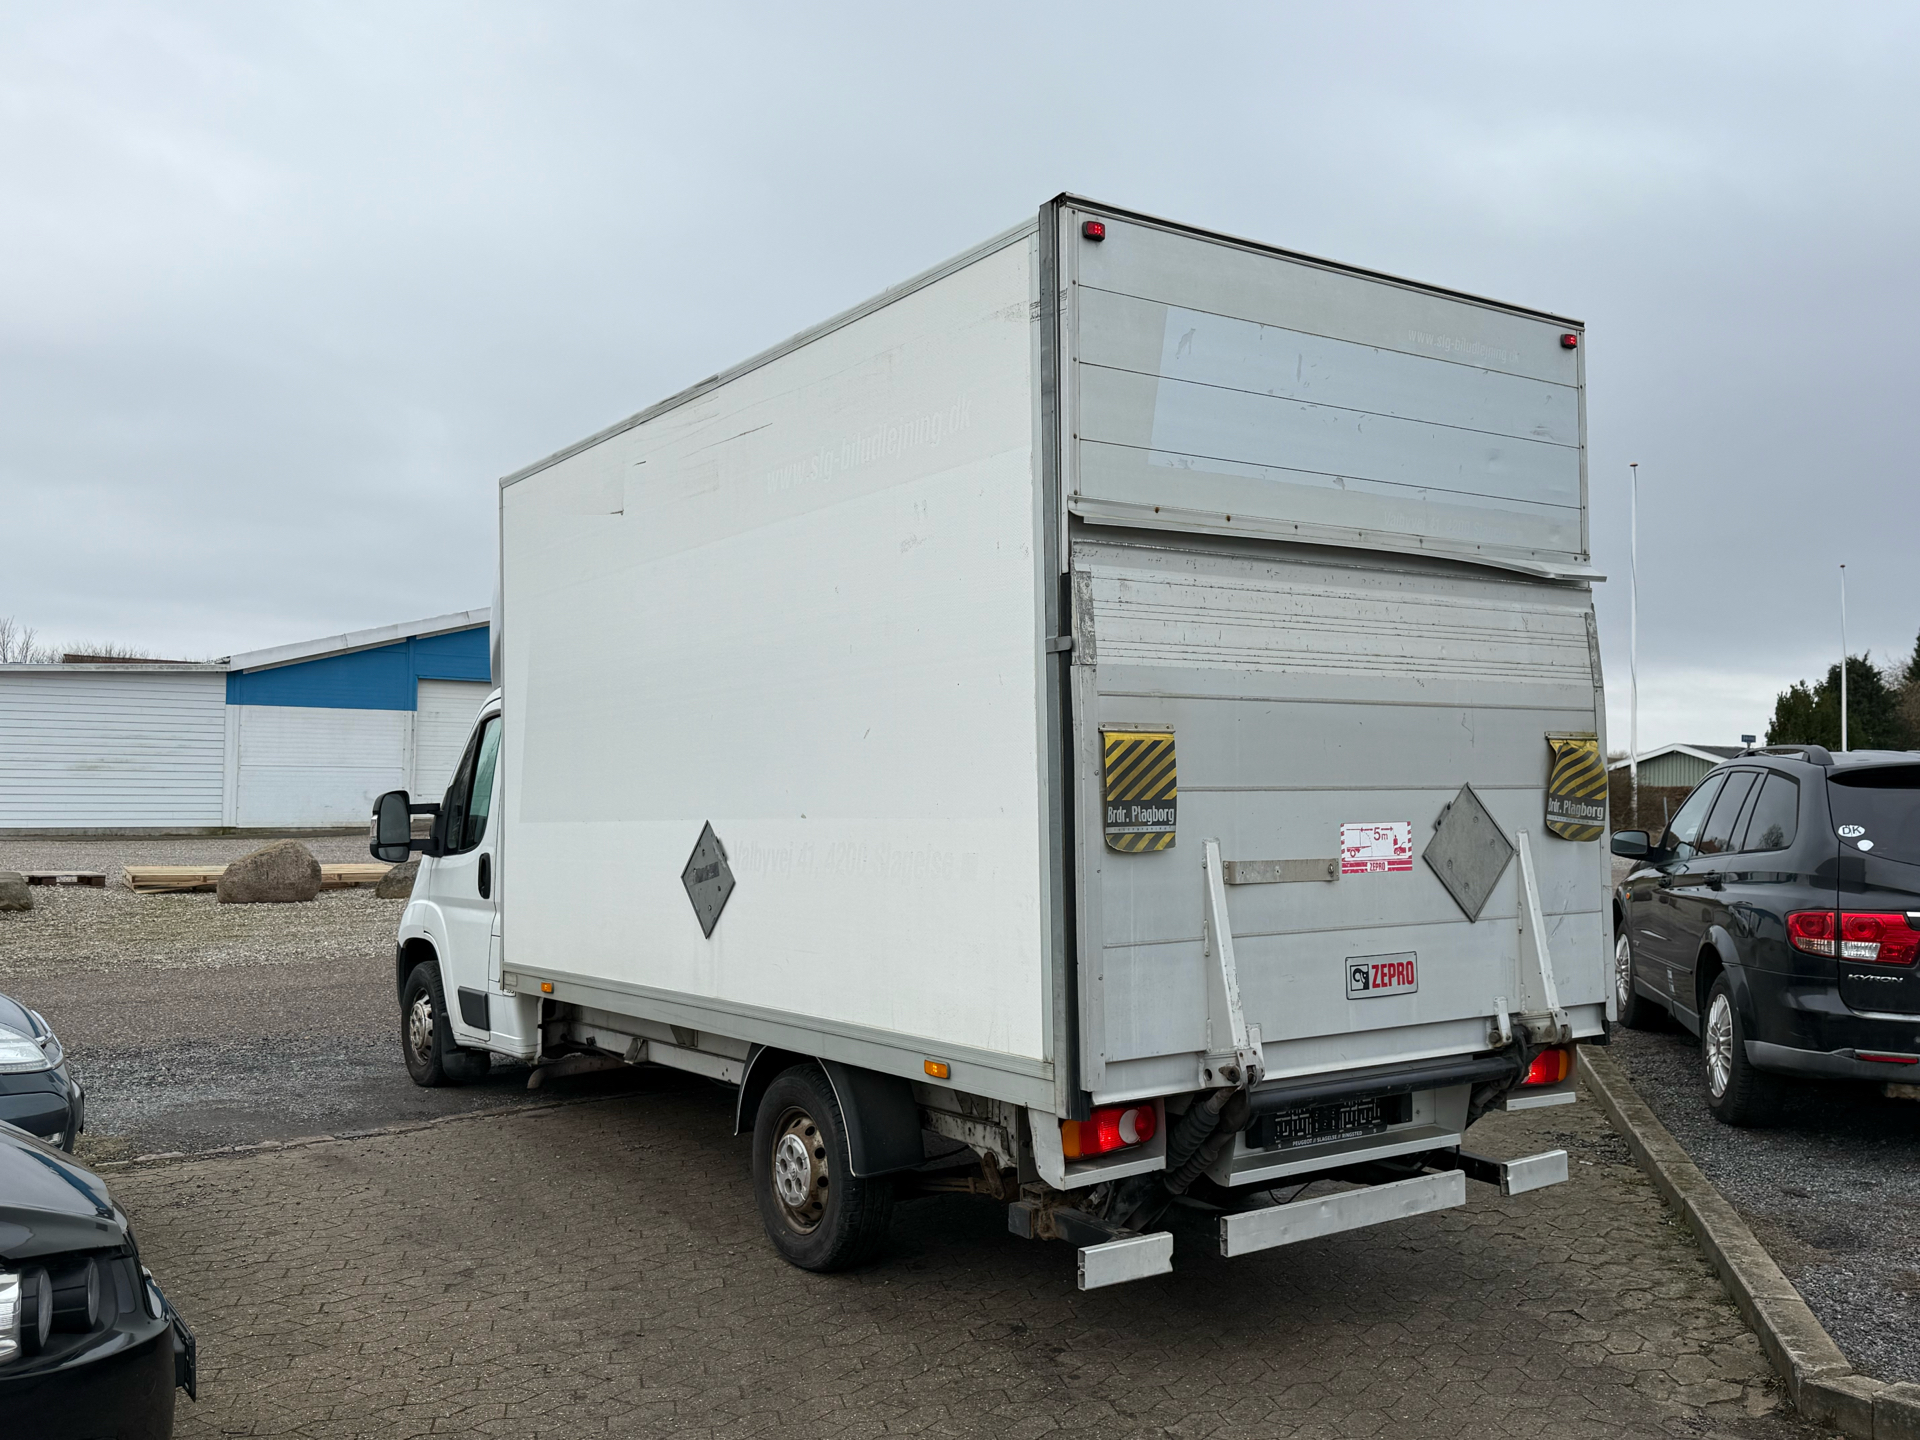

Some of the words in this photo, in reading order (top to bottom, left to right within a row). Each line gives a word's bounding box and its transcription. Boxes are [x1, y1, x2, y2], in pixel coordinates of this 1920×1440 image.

[1408, 329, 1519, 364] www.slg-biludlejningdk
[766, 392, 972, 495] www.slg-biludlejning.dk
[1107, 805, 1130, 823] Brdr.
[1131, 805, 1175, 825] Plagborg
[1548, 797, 1562, 813] Brdr.
[1563, 800, 1604, 820] Plagborg
[1842, 826, 1862, 835] DK
[874, 841, 955, 886] Slagelse
[1369, 861, 1386, 872] ZEPRO
[1371, 960, 1415, 989] ZEPRO
[1848, 973, 1904, 984] KYRON
[1292, 1138, 1312, 1147] PEUGEOT
[1317, 1134, 1338, 1143] SLAGELSE
[1341, 1130, 1363, 1139] RINGSTED
